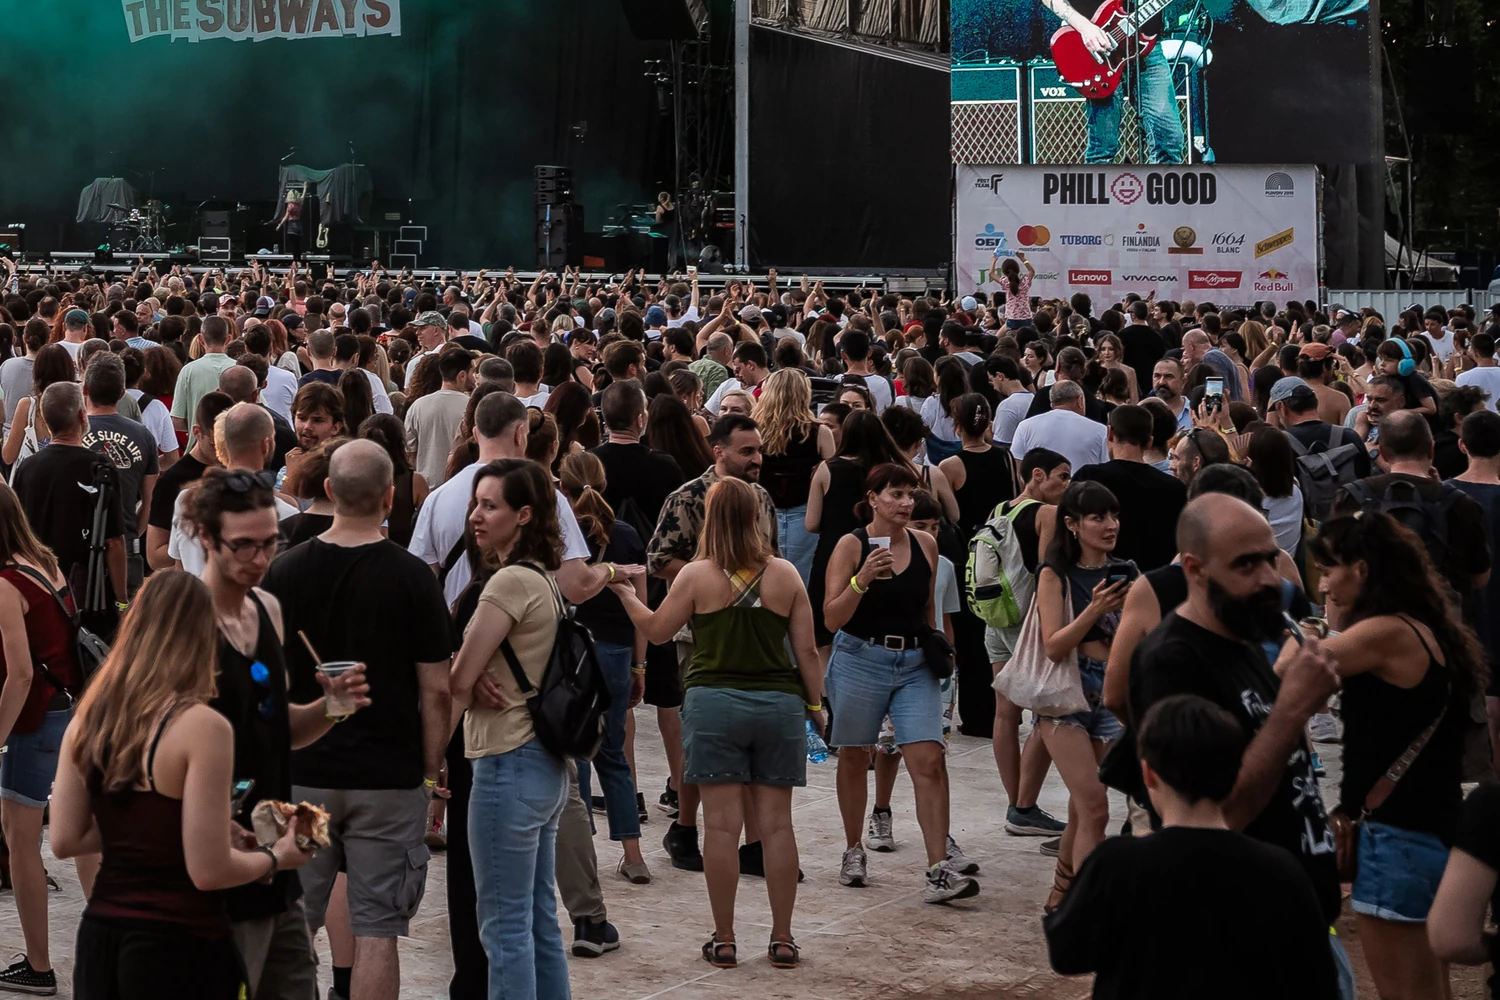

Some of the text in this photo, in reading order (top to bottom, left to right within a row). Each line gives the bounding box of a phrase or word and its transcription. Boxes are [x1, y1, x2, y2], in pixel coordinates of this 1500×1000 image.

[1040, 86, 1067, 97] VOX
[1043, 172, 1217, 205] PHILL GOOD
[1060, 234, 1102, 245] TUBORG
[1122, 236, 1161, 247] FINLANDIA
[1211, 232, 1246, 246] 1664
[1256, 232, 1294, 254] Schweppes
[1216, 246, 1241, 254] BLANC
[1071, 272, 1109, 282] Lenovo
[1121, 274, 1179, 282] VIVACOM
[1254, 282, 1294, 292] Red Bull
[97, 430, 129, 446] SLICE
[126, 440, 143, 463] LIFE
